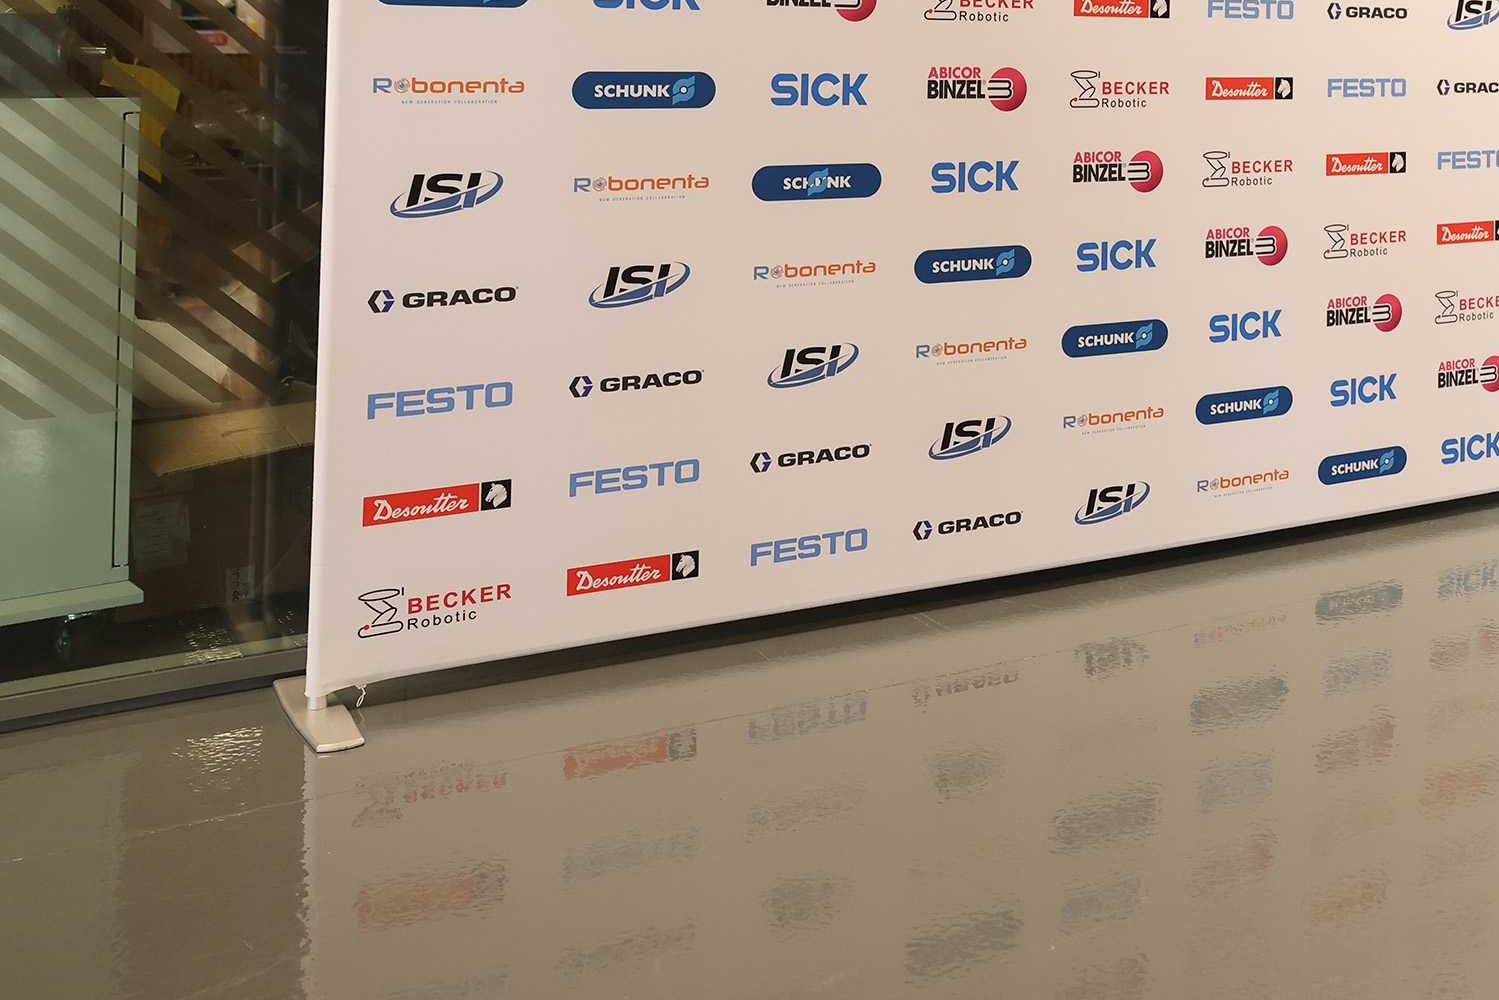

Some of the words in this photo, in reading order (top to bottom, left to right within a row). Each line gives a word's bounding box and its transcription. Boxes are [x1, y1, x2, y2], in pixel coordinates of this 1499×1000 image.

[960, 11, 1008, 22] Robotic
[1346, 7, 1407, 18] GRACO
[1454, 0, 1492, 27] ISI
[929, 67, 980, 78] ABICOR
[595, 85, 670, 97] SCHUNK
[771, 73, 868, 106] SICK
[1103, 82, 1168, 94] BECKER
[1212, 80, 1268, 96] Desoutter
[1328, 79, 1406, 97] FESTO
[1102, 98, 1146, 108] Robotic
[1074, 151, 1121, 163] ABICOR
[1332, 157, 1382, 172] Desoutter
[1232, 160, 1292, 174] BECKER
[931, 161, 1019, 193] SICK
[1232, 177, 1272, 186] Robotic
[405, 171, 482, 213] ISI
[1207, 228, 1249, 239] ABICOR
[1351, 231, 1406, 245] BECKER
[1442, 226, 1489, 241] Desoutter
[1077, 239, 1156, 272] SICK
[1350, 248, 1387, 257] Robotic
[933, 258, 994, 273] SCHUNK
[603, 262, 671, 303] ISI
[403, 287, 516, 308] GRACO
[1328, 296, 1366, 308] ABICOR
[1459, 310, 1494, 322] Robotic
[1209, 310, 1282, 343] SICK
[1078, 332, 1134, 347] SCHUNK
[779, 343, 841, 383] ISI
[1439, 359, 1474, 371] ABICOR
[600, 370, 702, 392] GRACO
[1330, 373, 1397, 407] SICK
[367, 382, 512, 420] FESTO
[1211, 399, 1261, 415] SCHUNK
[940, 416, 995, 455] ISI
[778, 445, 869, 467] GRACO
[1332, 459, 1378, 475] SCHUNK
[570, 459, 699, 497] FESTO
[374, 493, 468, 520] Desoutter
[1085, 482, 1136, 520] ISI
[938, 512, 1021, 534] GRACO
[751, 528, 867, 566] FESTO
[576, 564, 660, 590] Desoutter
[408, 584, 511, 614] BECKER
[408, 611, 476, 630] Robotic
